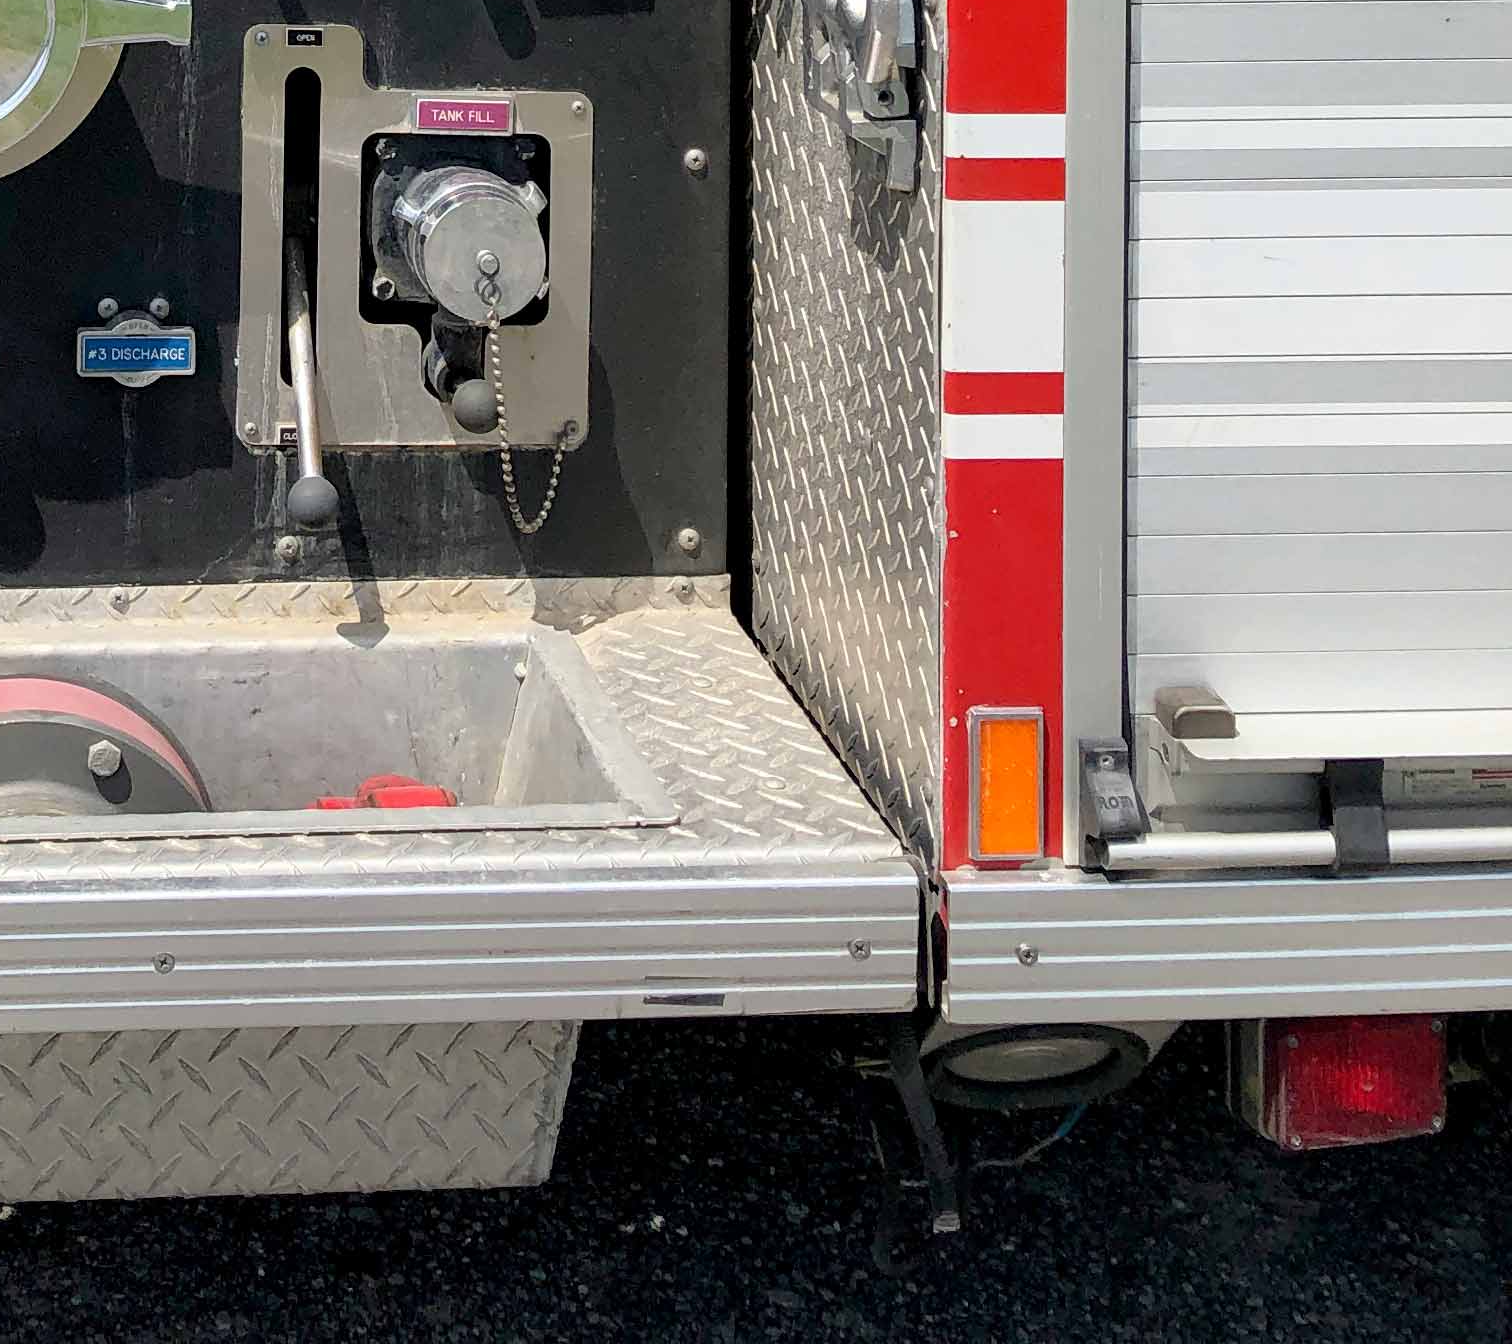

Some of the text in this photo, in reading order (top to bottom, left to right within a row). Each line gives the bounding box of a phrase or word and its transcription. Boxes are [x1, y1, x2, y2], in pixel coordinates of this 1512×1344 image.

[296, 34, 316, 42] OPEN
[431, 109, 495, 123] TANK FILL
[88, 348, 185, 361] #3 DISCHARGE
